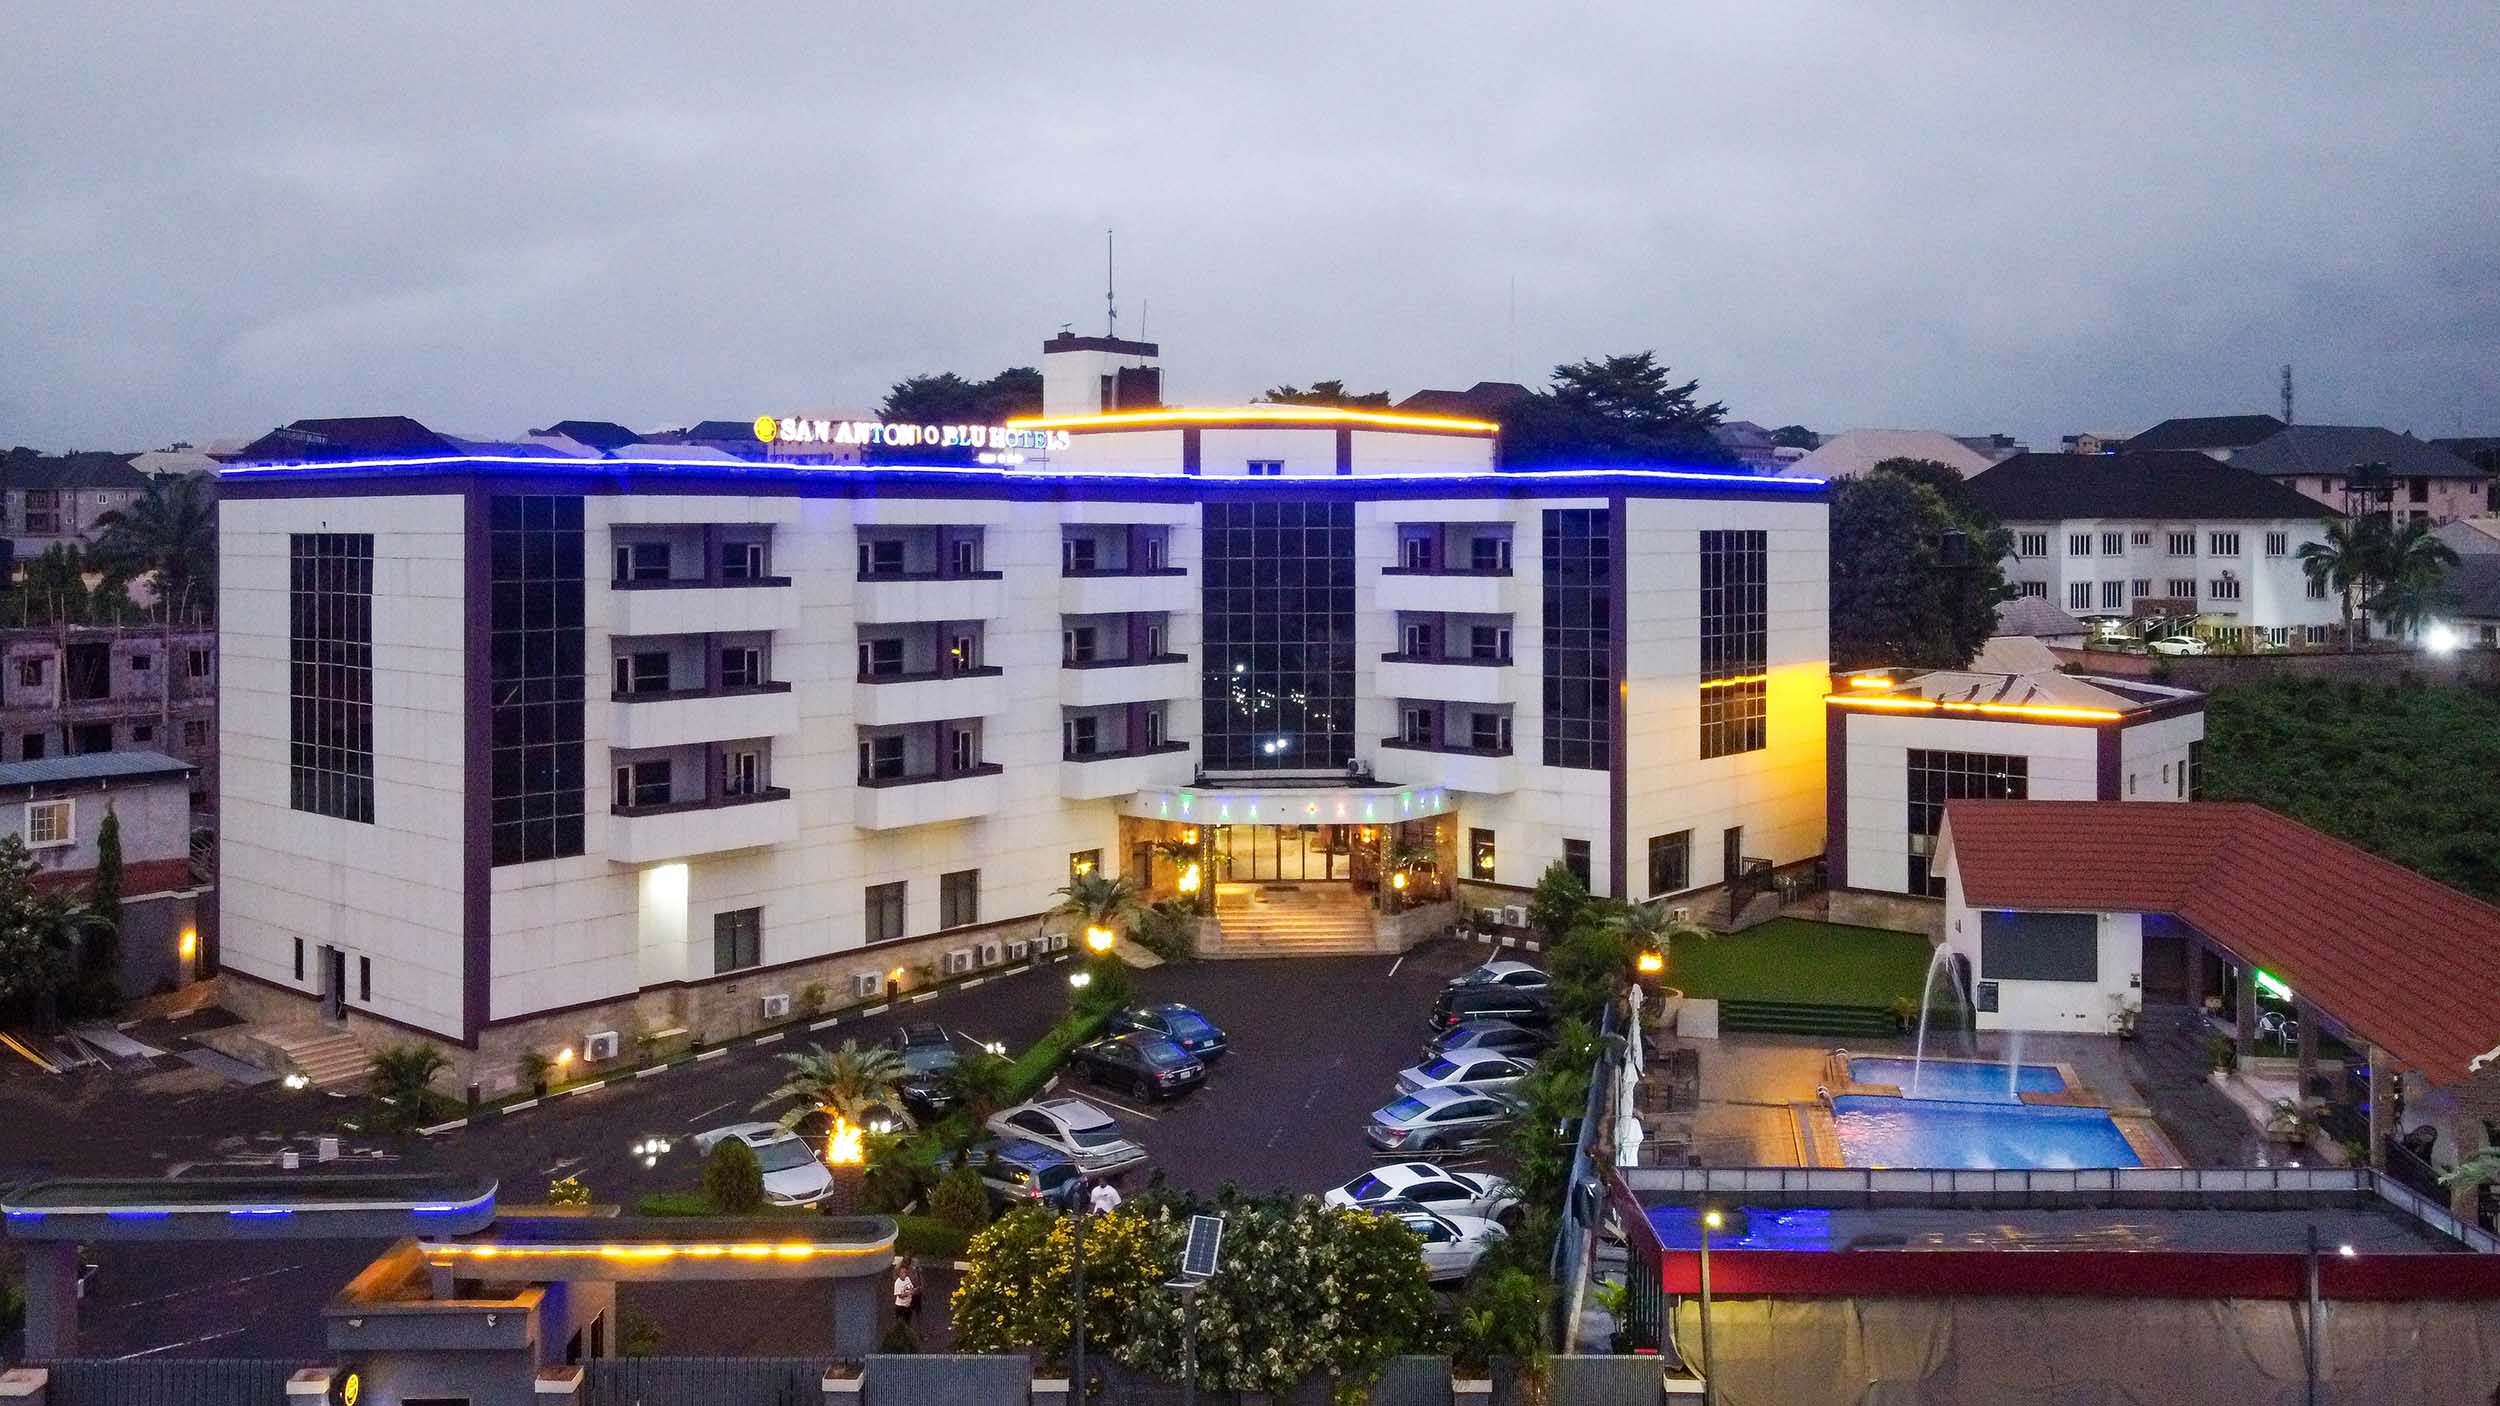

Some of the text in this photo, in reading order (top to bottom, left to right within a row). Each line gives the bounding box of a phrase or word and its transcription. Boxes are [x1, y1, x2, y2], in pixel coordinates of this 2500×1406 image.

[780, 418, 830, 442] SAN
[941, 425, 987, 447] BLU
[989, 427, 1071, 451] HOTELS
